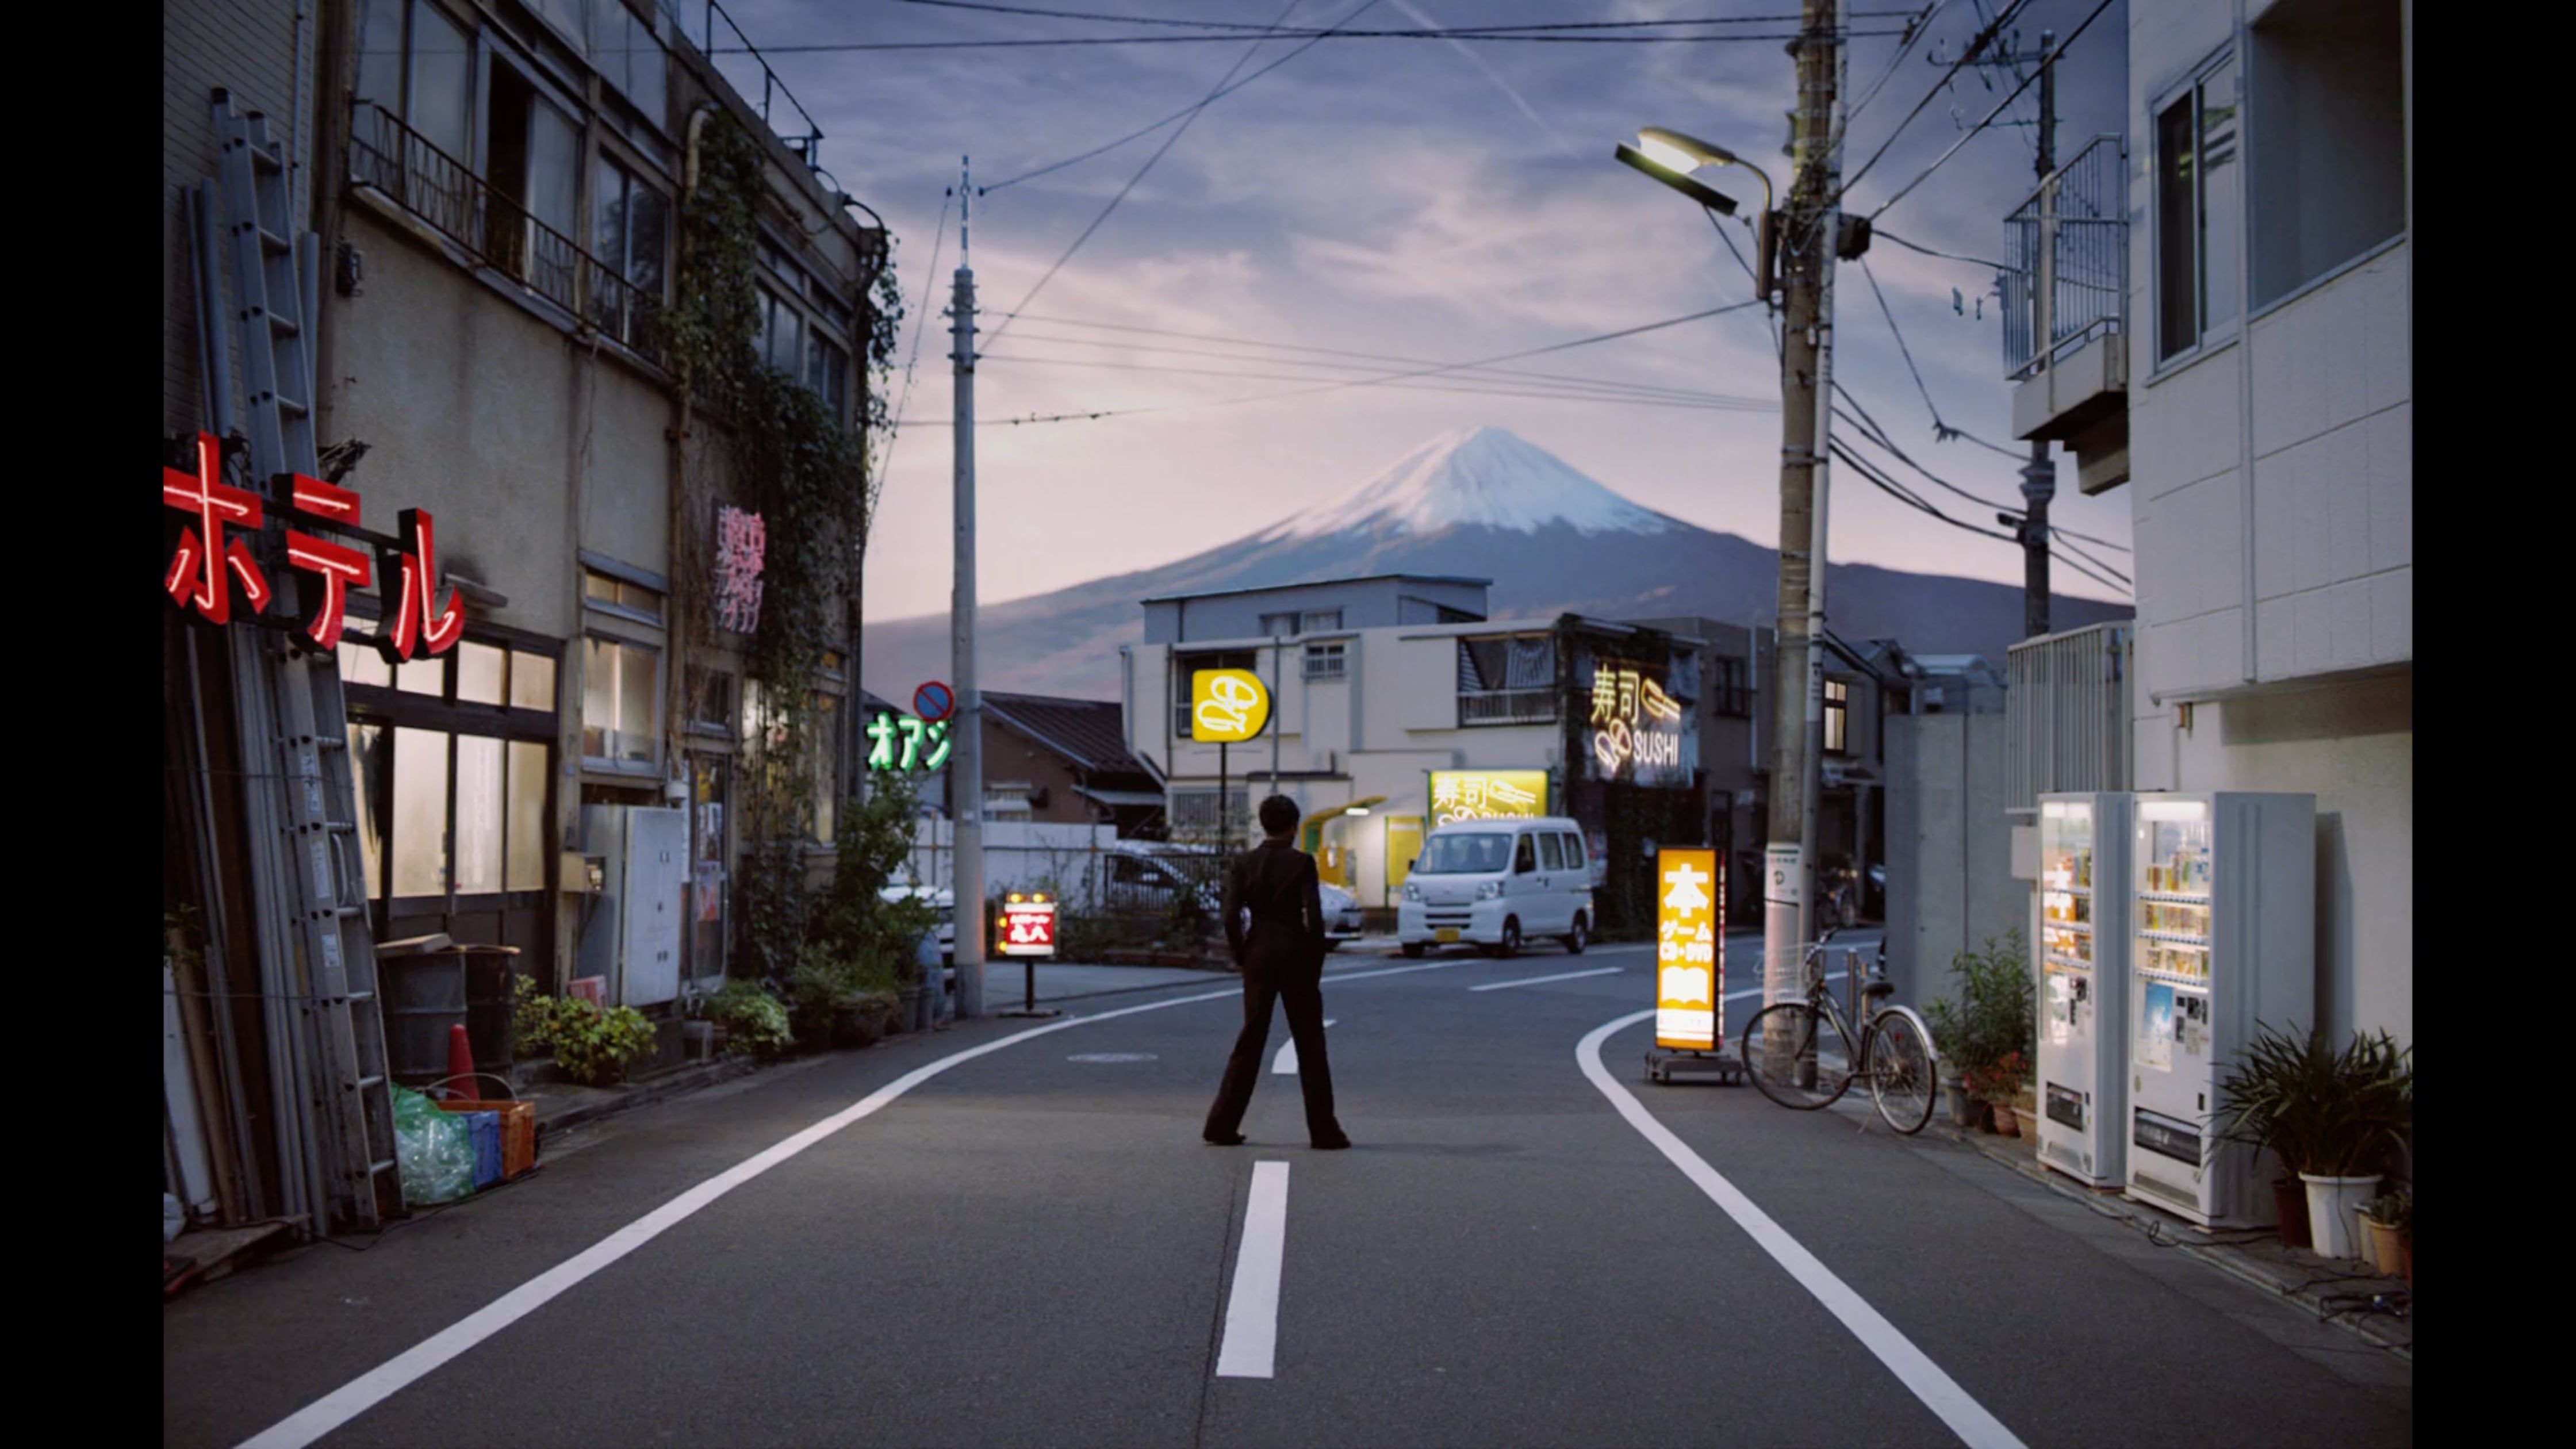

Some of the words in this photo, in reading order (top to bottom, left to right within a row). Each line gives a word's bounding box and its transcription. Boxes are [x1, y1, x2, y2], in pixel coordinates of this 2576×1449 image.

[163, 430, 465, 661] ホテル
[1590, 663, 1639, 725] 寿司
[1633, 729, 1678, 766] SUSHI
[1663, 862, 1709, 918] 本
